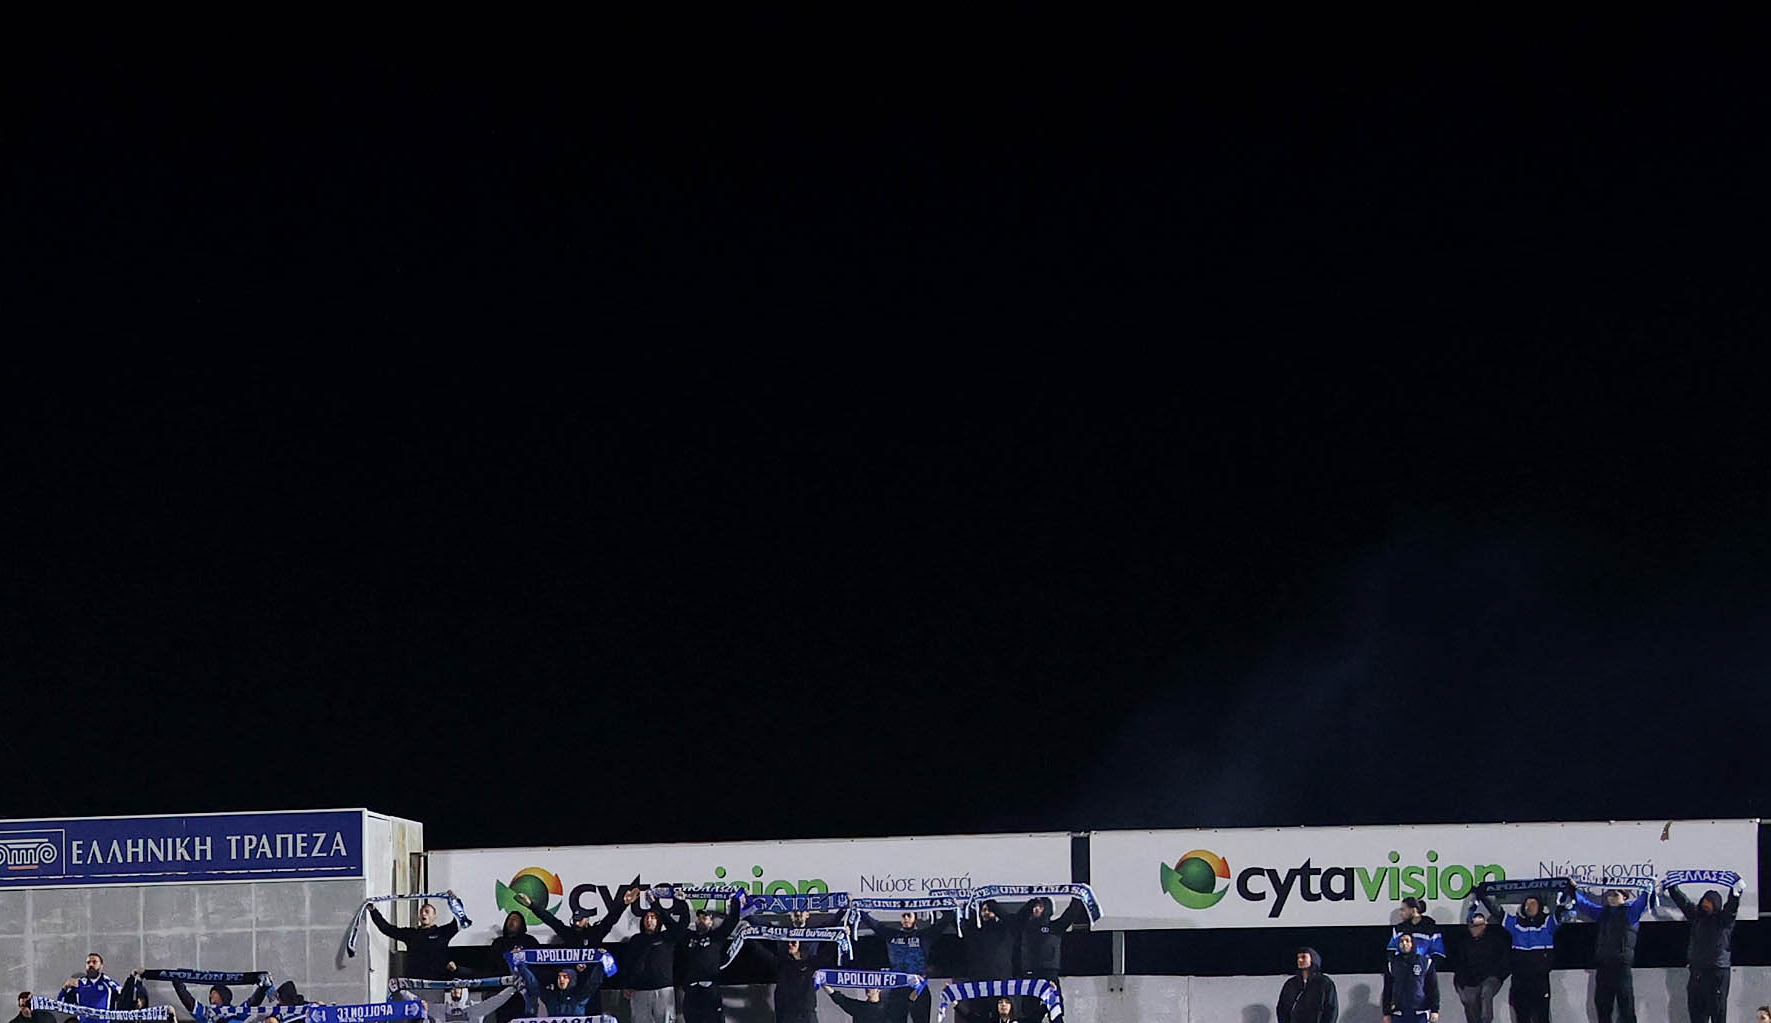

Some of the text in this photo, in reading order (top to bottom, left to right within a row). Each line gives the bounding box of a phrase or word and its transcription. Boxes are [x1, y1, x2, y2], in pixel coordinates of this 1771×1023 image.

[71, 832, 348, 865] ΕΛΛΗΝΙΚΗ ΤΡΑΠΕΖΑ
[569, 865, 829, 918] cytaviion
[860, 873, 916, 893] Νιώσε
[1236, 850, 1506, 918] cytavision
[536, 948, 596, 962] APOLLON FC
[837, 972, 897, 986] APOLLON FC
